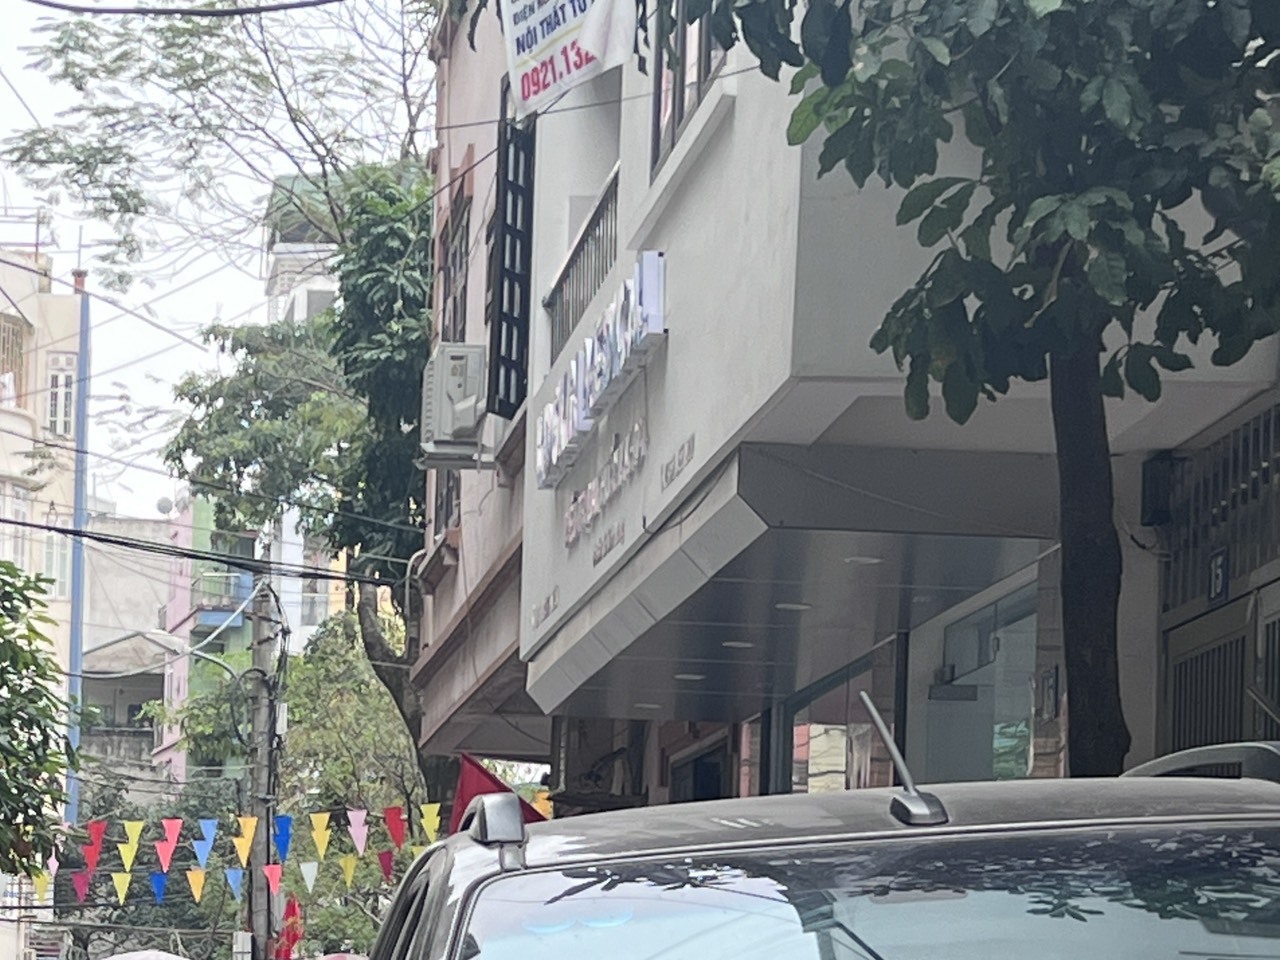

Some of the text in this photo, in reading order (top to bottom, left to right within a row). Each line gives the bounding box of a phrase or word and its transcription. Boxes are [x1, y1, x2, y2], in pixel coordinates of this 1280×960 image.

[516, 25, 538, 55] NỘI
[521, 39, 597, 101] 0921.13
[1209, 554, 1224, 599] 15
